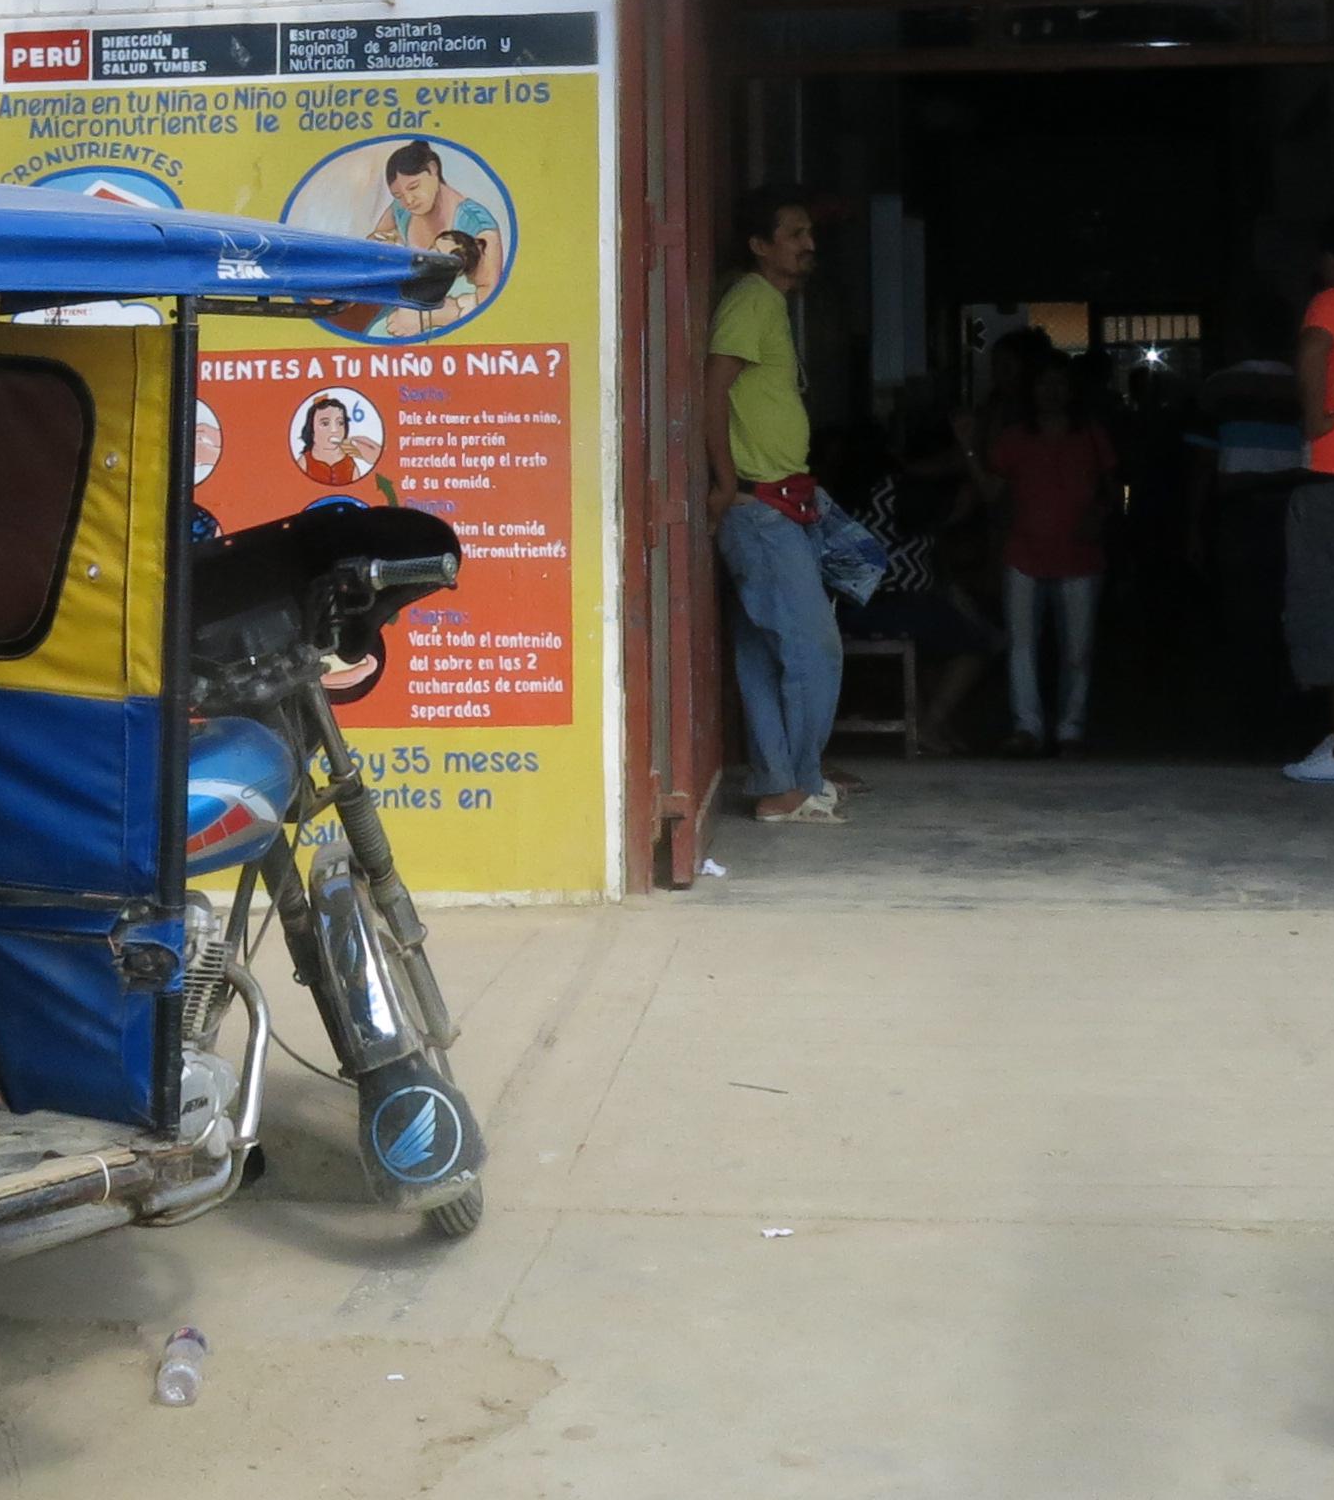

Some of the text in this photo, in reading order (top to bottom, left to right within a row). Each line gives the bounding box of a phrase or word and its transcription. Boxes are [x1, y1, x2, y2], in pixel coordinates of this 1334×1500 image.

[102, 30, 173, 49] DIRECCIÓN
[289, 22, 442, 42] Estrategia Sanitaria
[12, 39, 82, 69] PERÚ
[102, 46, 190, 62] REGIONAL DE
[289, 35, 512, 58] Regional de alimentación y
[101, 60, 208, 76] SALUD TUMBES
[289, 53, 356, 71] Nutrición
[91, 96, 117, 116] en
[127, 90, 152, 113] tu
[156, 89, 208, 115] Niña
[214, 92, 229, 111] o
[233, 86, 287, 111] Niño
[295, 83, 399, 112] quieres
[28, 113, 239, 140] Micronutrientes
[255, 111, 280, 133] le
[298, 108, 374, 132] debes
[0, 140, 185, 187] CRONUTRIENTES.
[200, 358, 301, 382] RIENTES
[307, 357, 325, 379] A
[425, 411, 439, 426] de
[399, 430, 506, 451] primero la porción
[399, 450, 548, 471] mezclada luego el resto
[401, 475, 417, 490] de
[423, 477, 439, 489] su
[453, 520, 546, 537] bien la comida
[446, 631, 476, 647] todo
[479, 632, 492, 648] el
[495, 632, 563, 650] contenido
[410, 653, 538, 672] del sobre en las 2
[408, 676, 564, 695] cucharadas de comida
[410, 700, 492, 721] separadas
[369, 751, 386, 782] y
[391, 746, 431, 774] 35
[444, 750, 540, 774] meses
[370, 783, 494, 811] entes en
